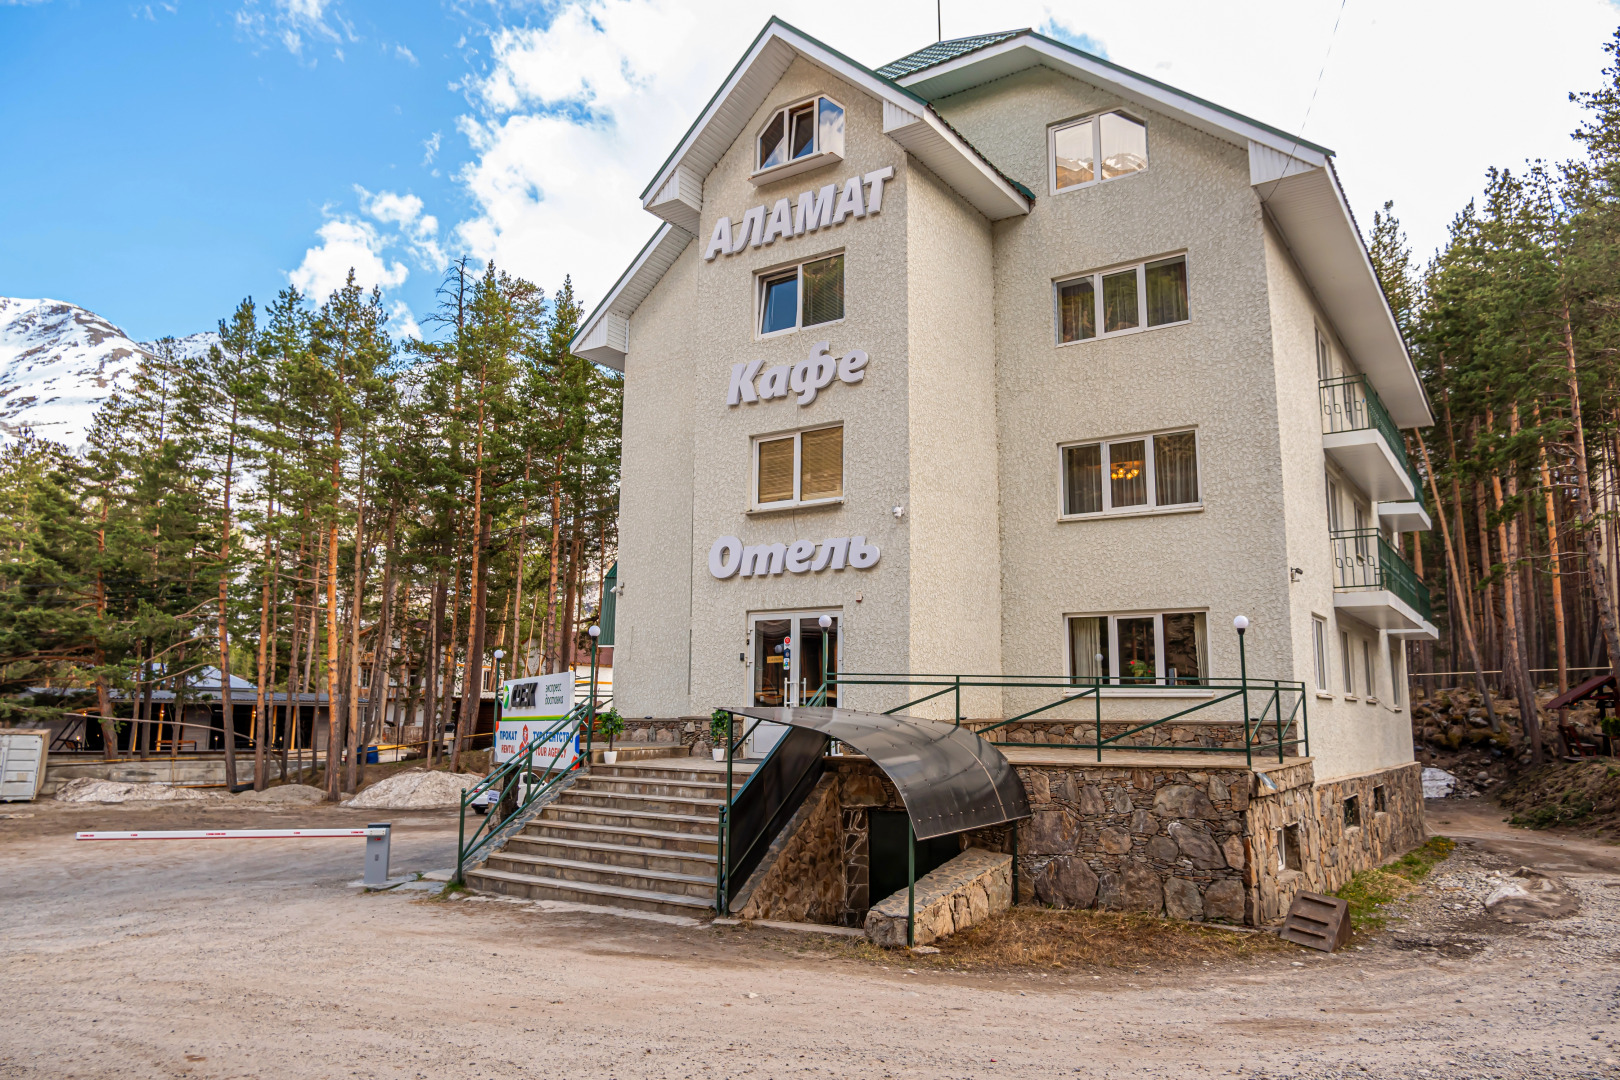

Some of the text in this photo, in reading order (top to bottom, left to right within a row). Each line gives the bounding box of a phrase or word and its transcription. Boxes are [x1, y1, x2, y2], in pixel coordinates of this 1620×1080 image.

[703, 165, 895, 261] АЛАМАТ
[726, 341, 869, 406] Кафе
[708, 535, 881, 579] Отель
[499, 731, 518, 741] ПРОКАТ
[501, 745, 516, 754] RENTAL
